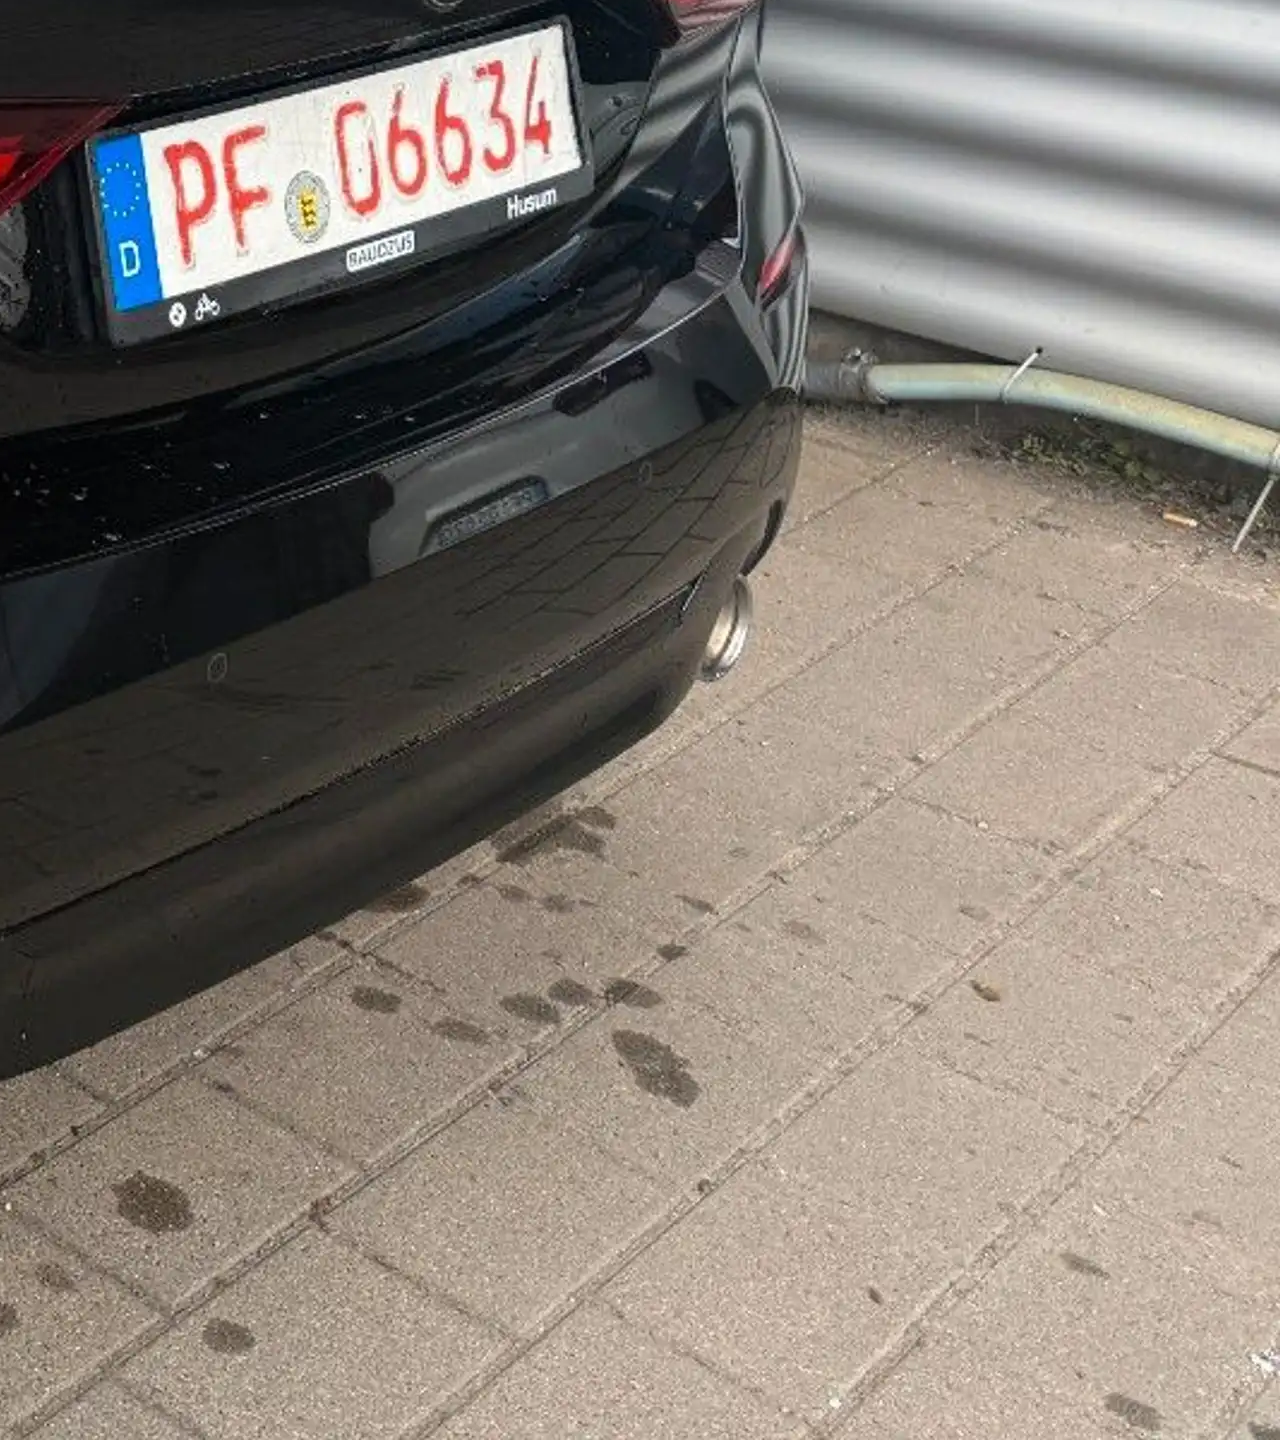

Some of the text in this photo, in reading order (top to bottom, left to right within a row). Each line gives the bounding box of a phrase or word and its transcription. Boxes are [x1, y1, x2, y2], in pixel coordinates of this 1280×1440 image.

[162, 125, 272, 268] PF
[333, 49, 553, 216] 06634
[507, 188, 558, 220] Husum
[119, 240, 141, 277] D
